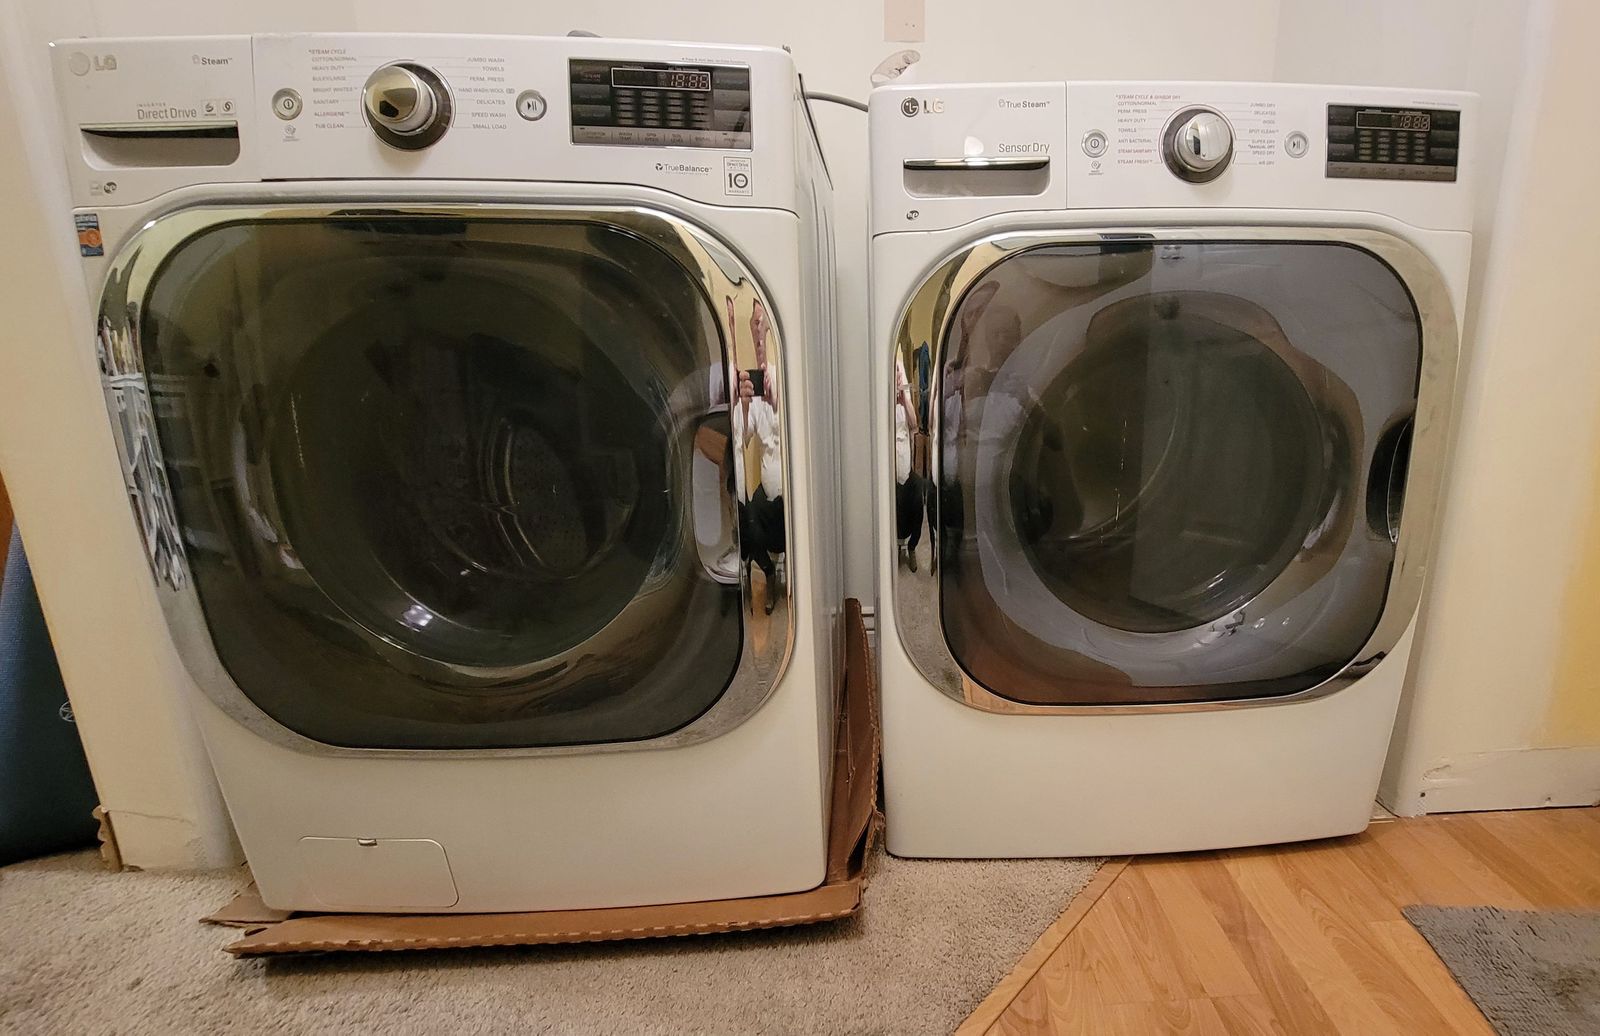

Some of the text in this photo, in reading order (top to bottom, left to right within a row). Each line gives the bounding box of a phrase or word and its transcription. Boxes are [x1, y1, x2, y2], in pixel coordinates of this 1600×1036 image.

[94, 54, 117, 71] LG
[137, 107, 197, 119] Direct Drive
[923, 99, 944, 114] LG
